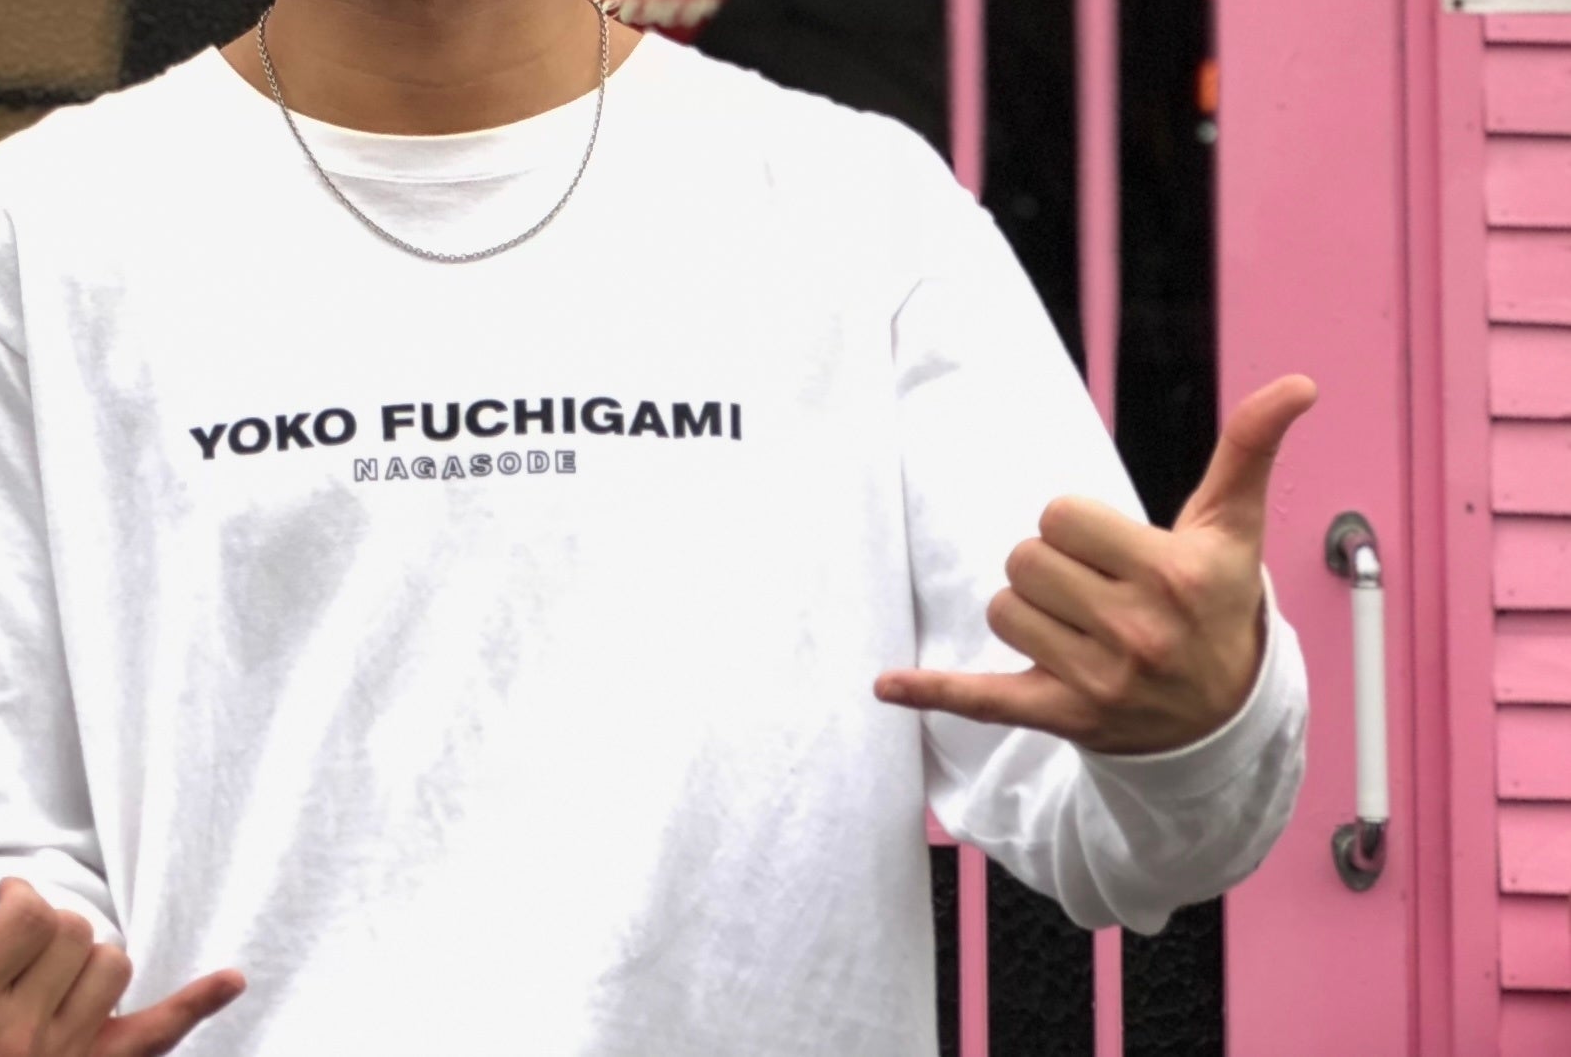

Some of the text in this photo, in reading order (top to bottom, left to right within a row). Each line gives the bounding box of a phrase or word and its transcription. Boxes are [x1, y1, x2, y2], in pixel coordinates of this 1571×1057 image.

[189, 396, 742, 460] YOKO FUCHIGAMI
[353, 449, 577, 483] NAGASODE
